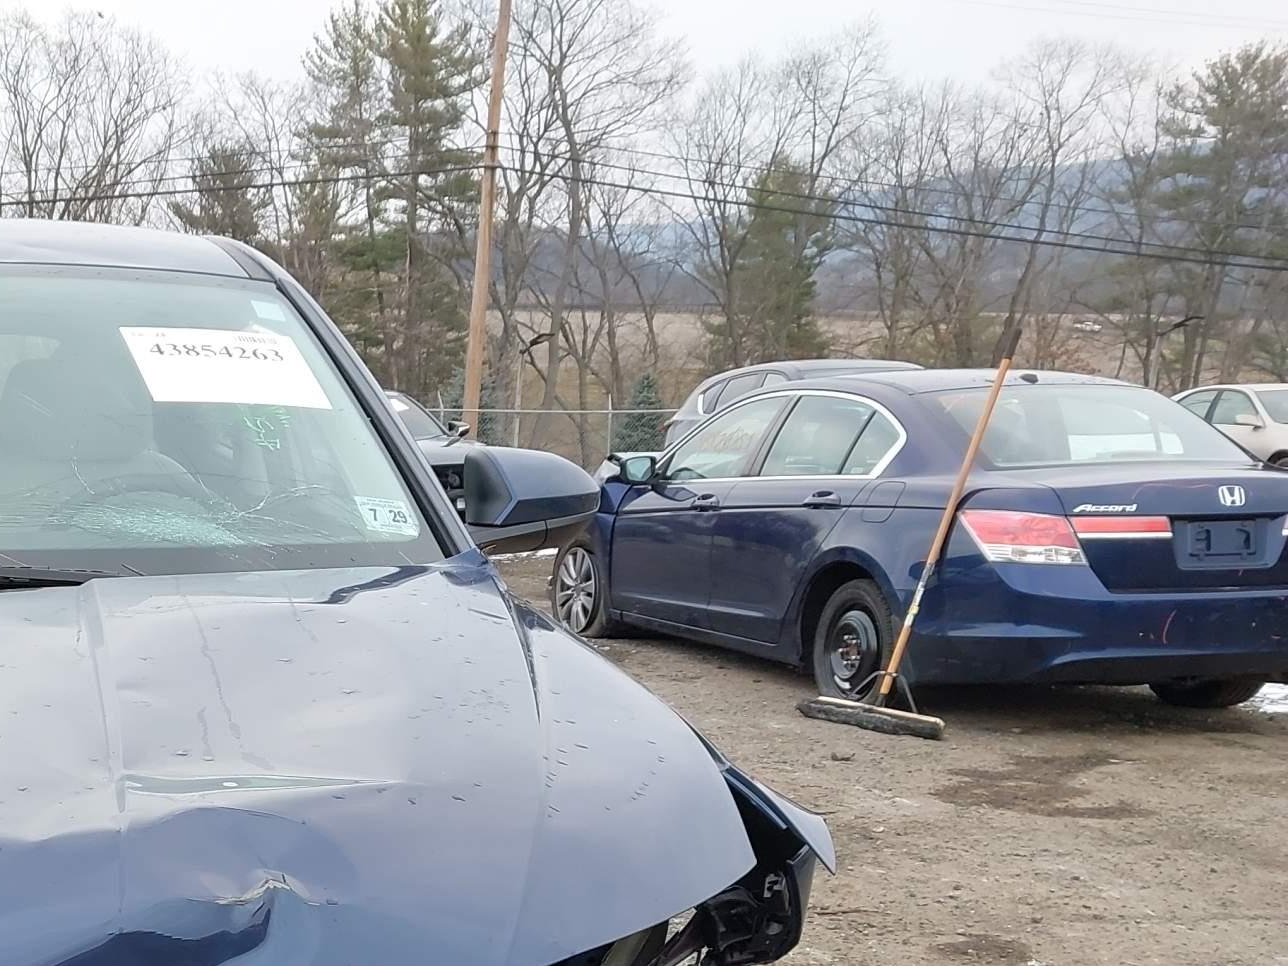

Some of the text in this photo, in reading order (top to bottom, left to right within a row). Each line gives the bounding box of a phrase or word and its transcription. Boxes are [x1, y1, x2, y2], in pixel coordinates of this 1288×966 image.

[149, 342, 285, 362] 43854263
[368, 507, 408, 524] 7 29
[1072, 503, 1139, 513] Accord
